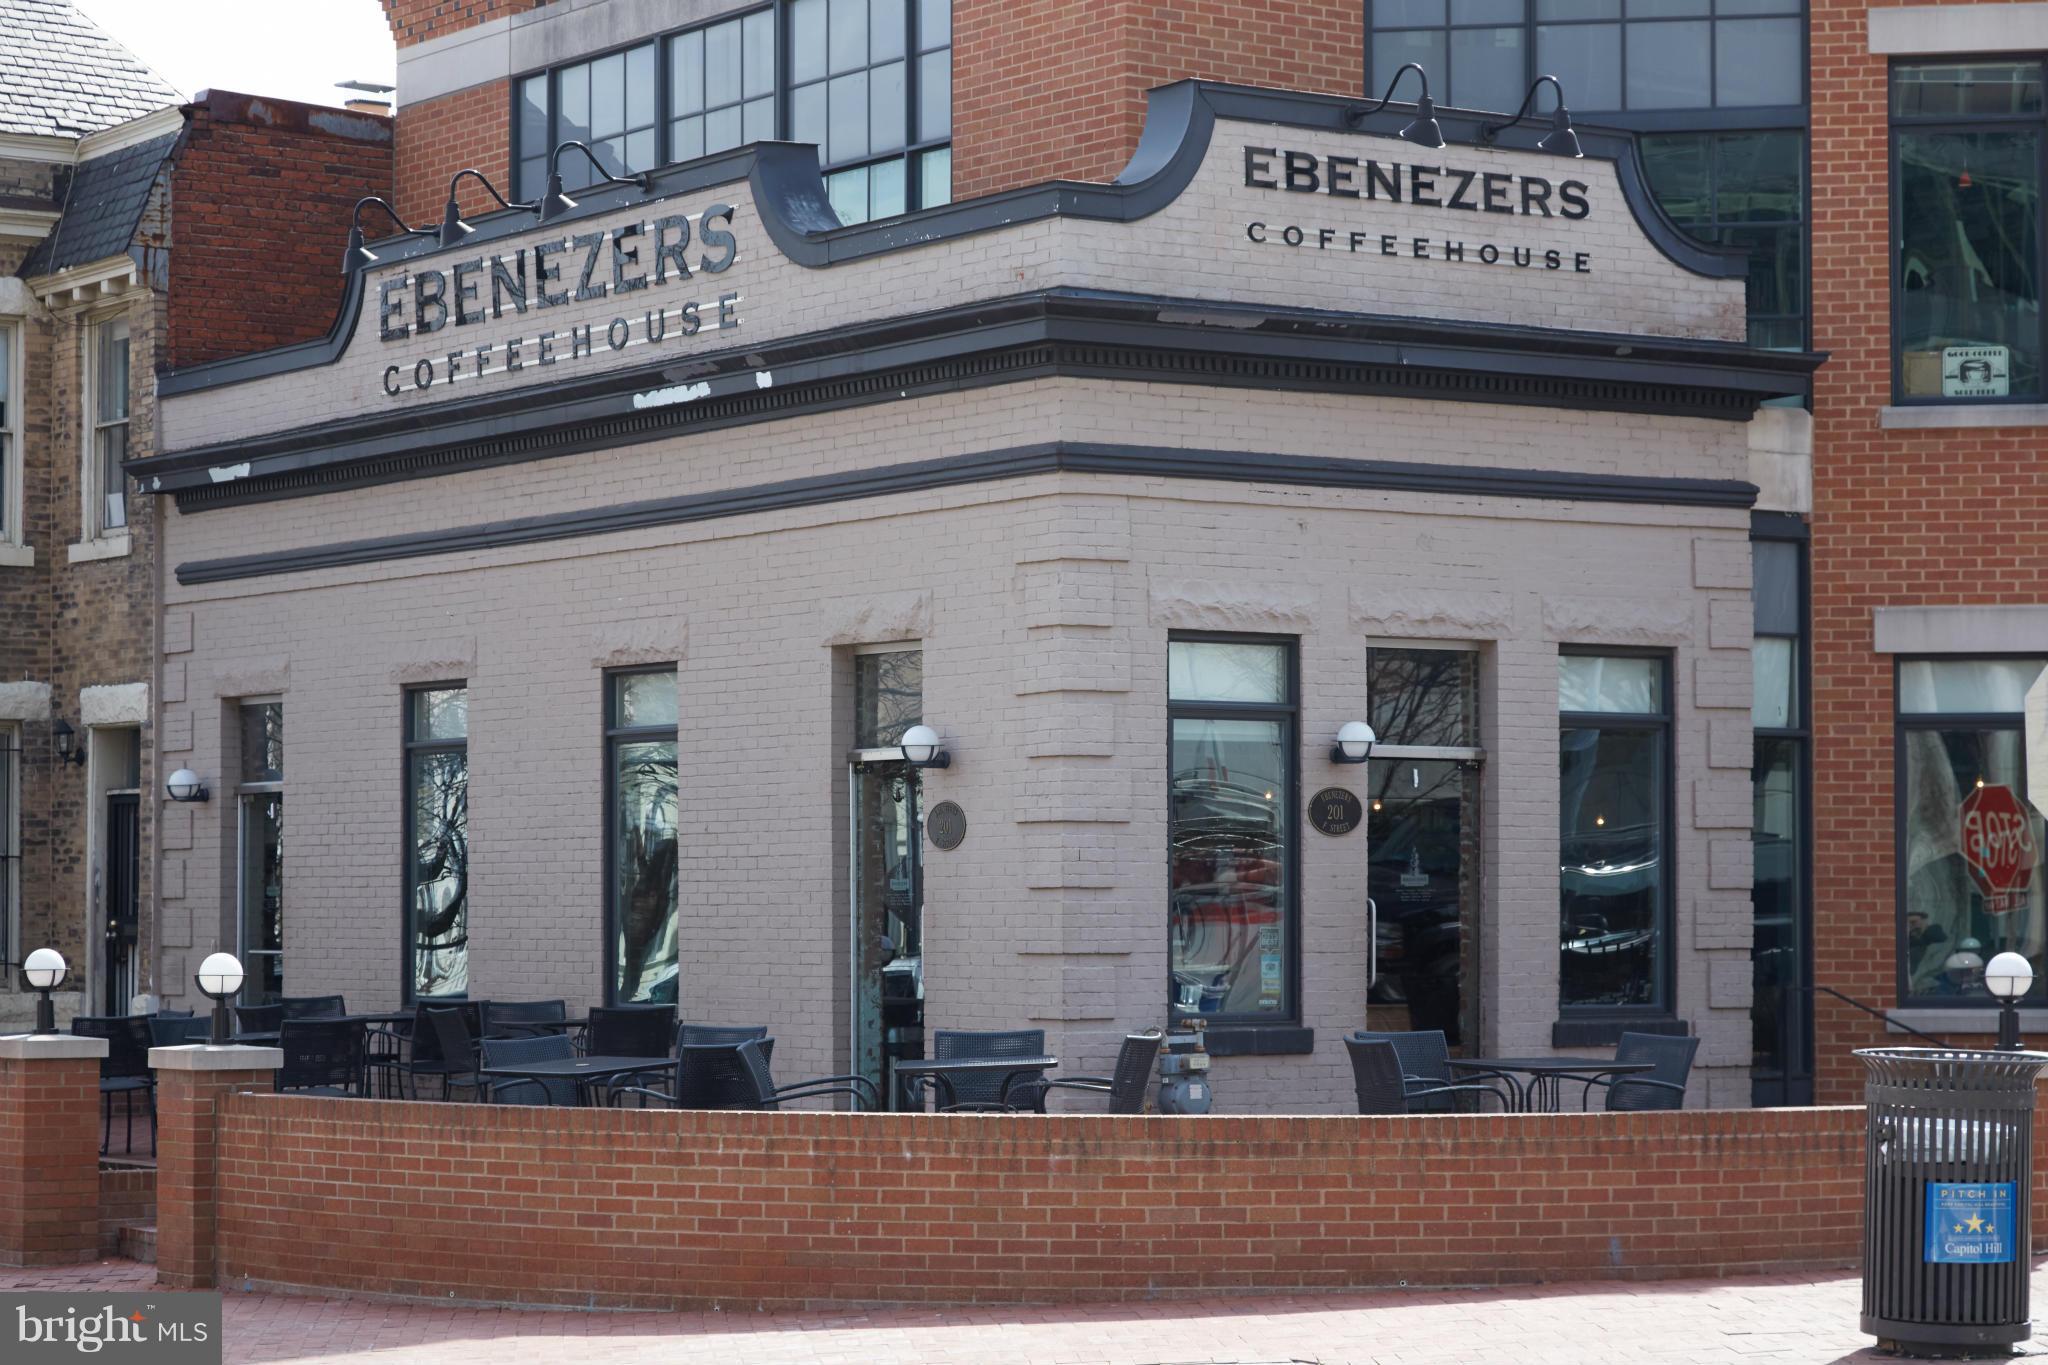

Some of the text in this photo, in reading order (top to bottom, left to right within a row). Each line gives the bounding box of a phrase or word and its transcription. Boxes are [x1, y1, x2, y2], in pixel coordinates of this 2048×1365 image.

[1244, 145, 1590, 220] EBENEZERS
[1247, 222, 1591, 273] COFFEEHOUSE
[380, 203, 737, 342] EBENEZERS
[383, 292, 737, 396] COFFEEHOUSE
[1327, 804, 1344, 820] 201
[1330, 822, 1350, 832] STREET
[1941, 1189, 2007, 1199] PITCH IN
[1944, 1242, 2003, 1257] Capitol Hill
